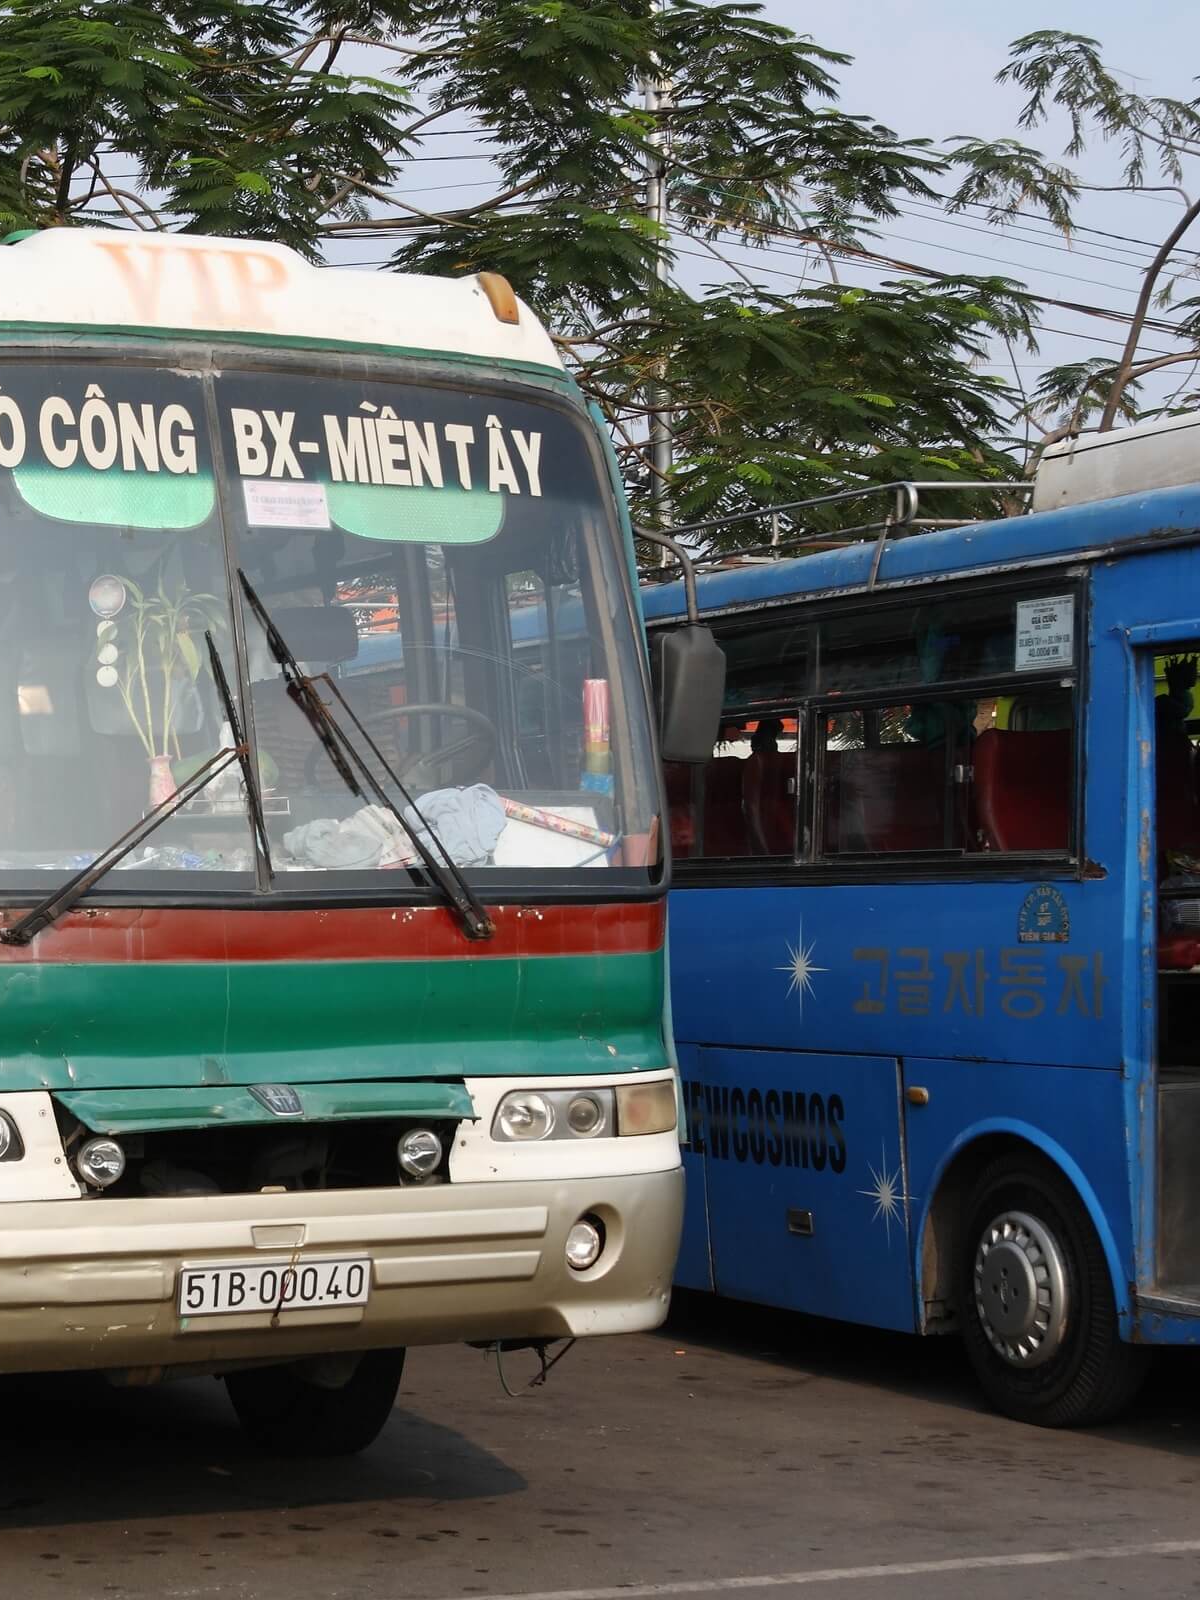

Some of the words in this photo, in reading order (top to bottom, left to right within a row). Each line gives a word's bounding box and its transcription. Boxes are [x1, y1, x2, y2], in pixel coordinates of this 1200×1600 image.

[94, 242, 289, 329] VIP
[39, 383, 198, 474] CÔNG
[444, 414, 542, 497] TÂY
[186, 1264, 365, 1309] 51B-000.40
